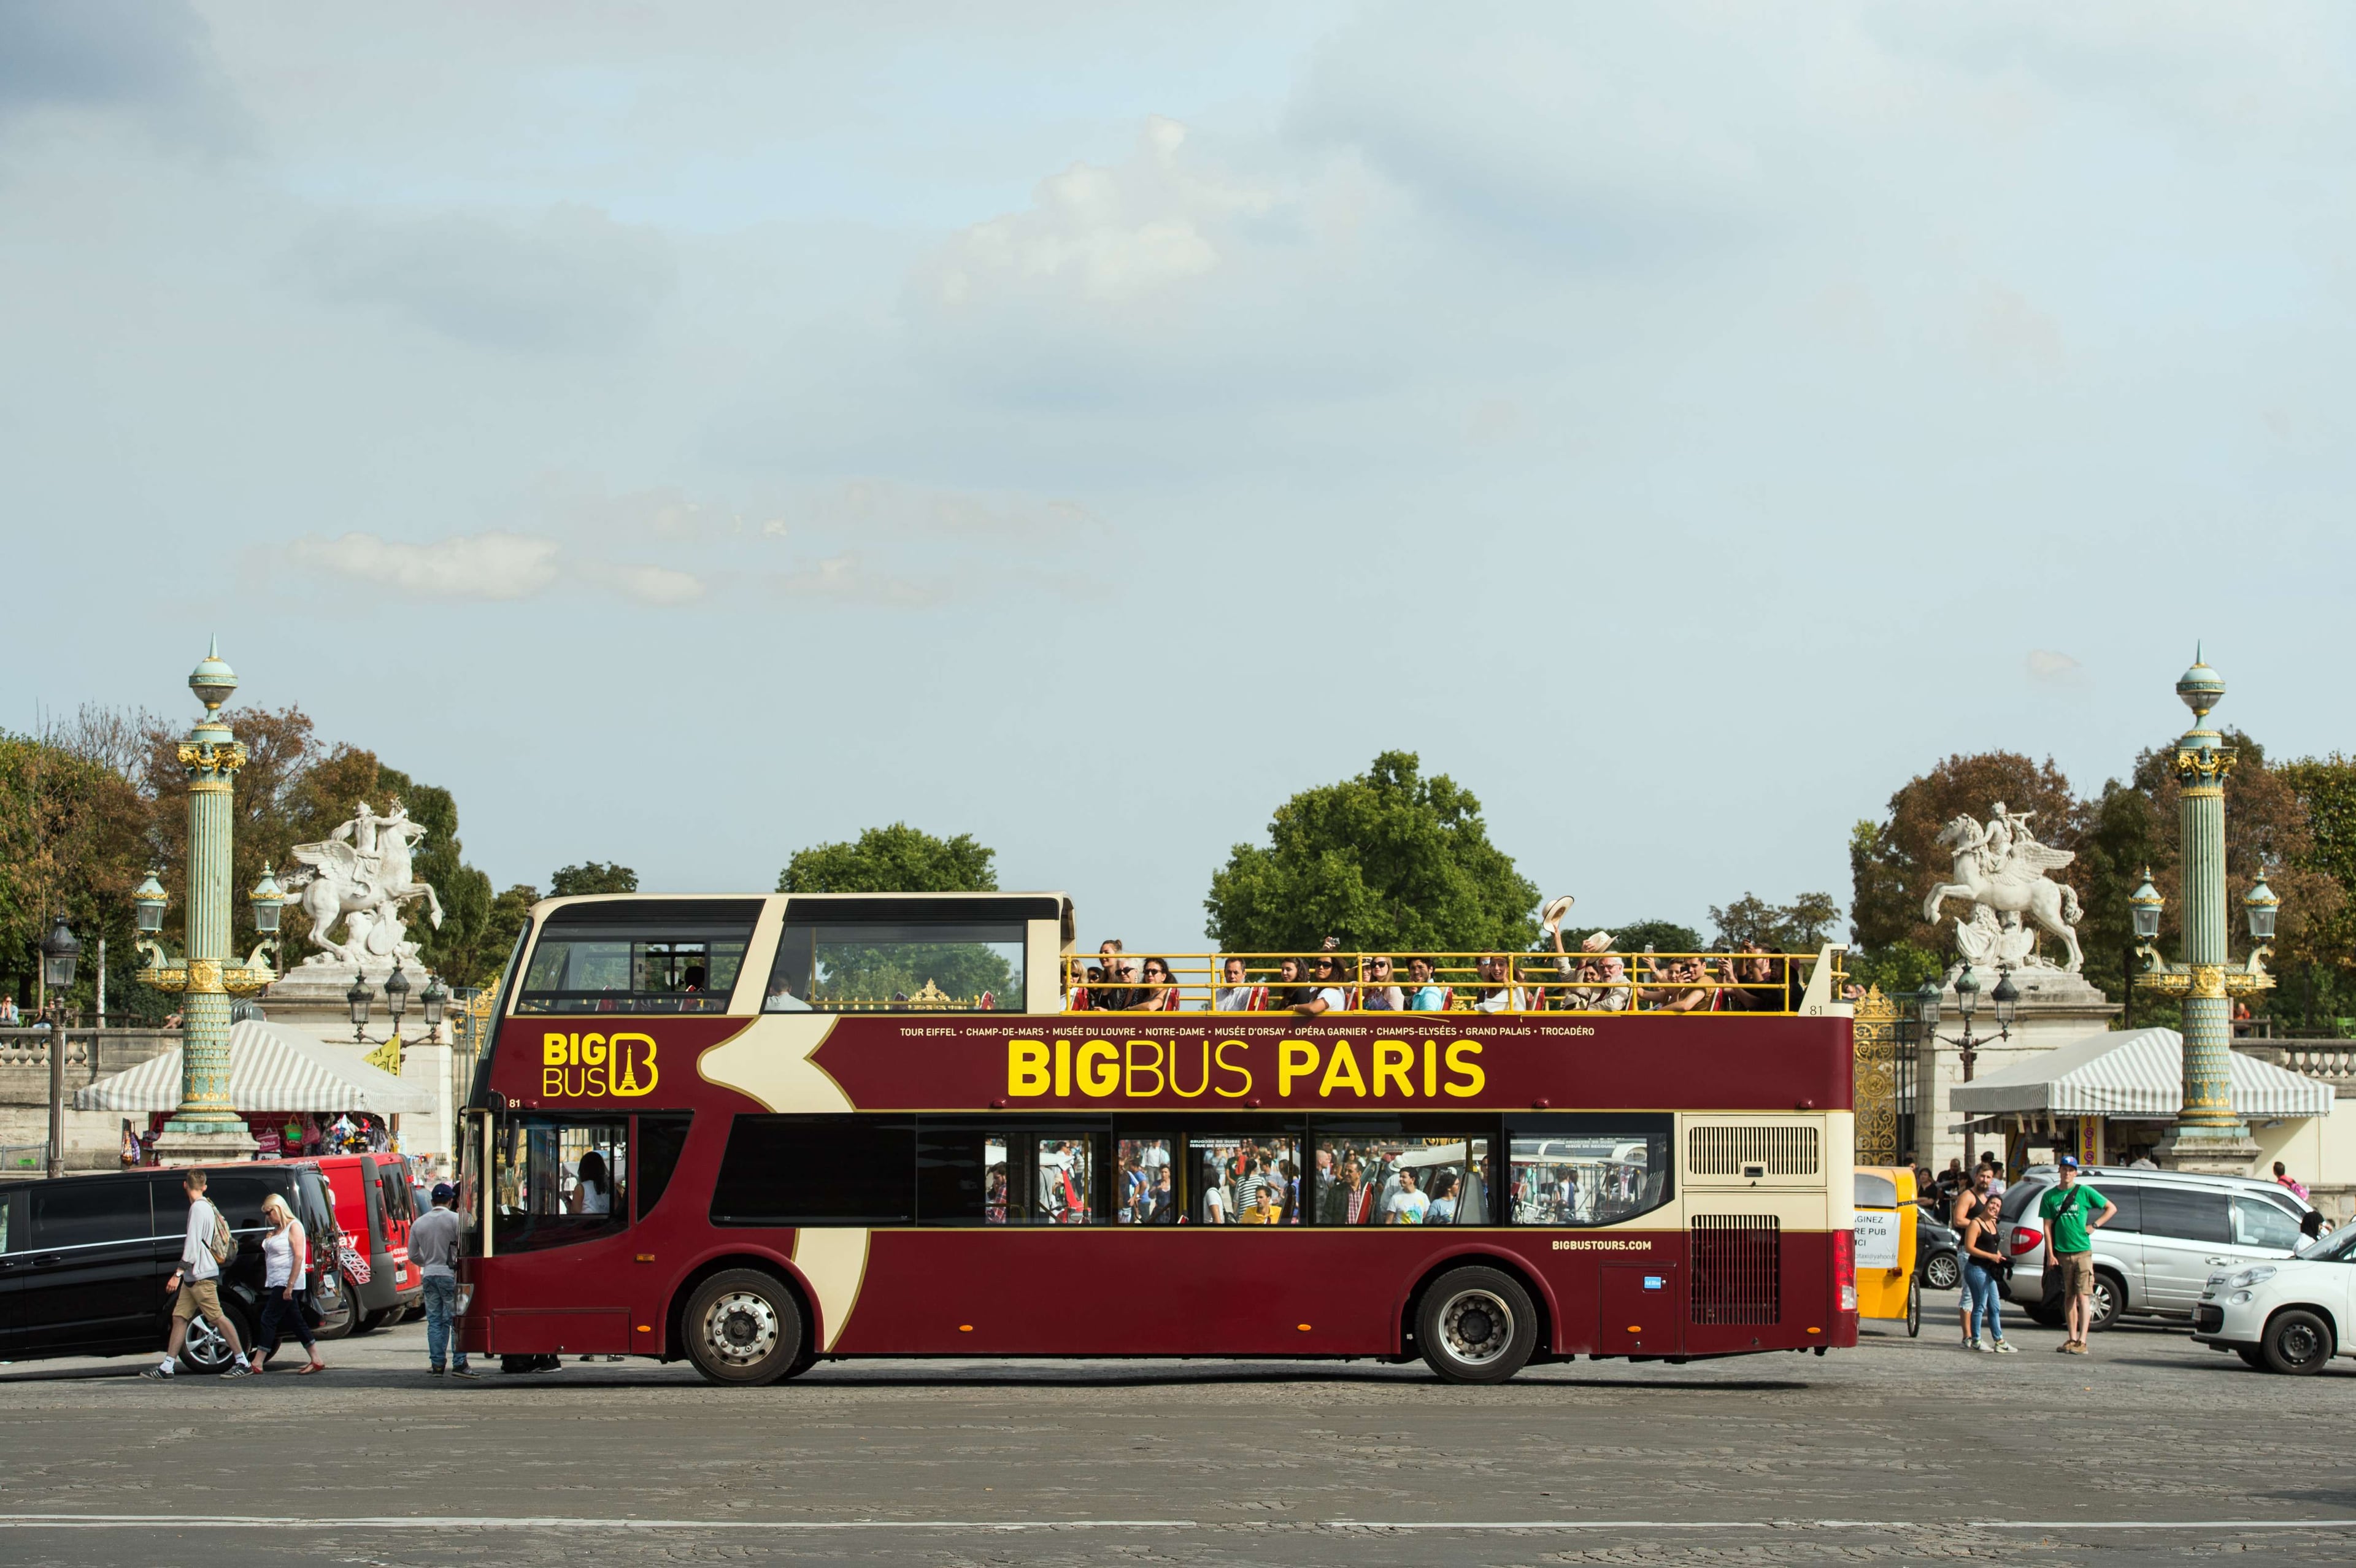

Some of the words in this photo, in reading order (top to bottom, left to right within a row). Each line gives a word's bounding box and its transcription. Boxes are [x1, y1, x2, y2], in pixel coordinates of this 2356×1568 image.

[1810, 1005, 1822, 1016] 81
[966, 1028, 1044, 1036] CHAMP-DE-MARS
[1053, 1026, 1084, 1036] MUSÉE
[1215, 1026, 1245, 1036] MUSÉE
[1295, 1026, 1324, 1036] OPÉRA
[1377, 1026, 1457, 1036] CHAMPS-ELYSÉES
[1541, 1026, 1594, 1036] TROCADÉRO
[544, 1033, 607, 1066] BIG
[1279, 1040, 1485, 1097] PARIS
[543, 1068, 606, 1097] BUS
[509, 1099, 520, 1108] 81
[1552, 1241, 1652, 1250] BIGBUSTOURS.COM
